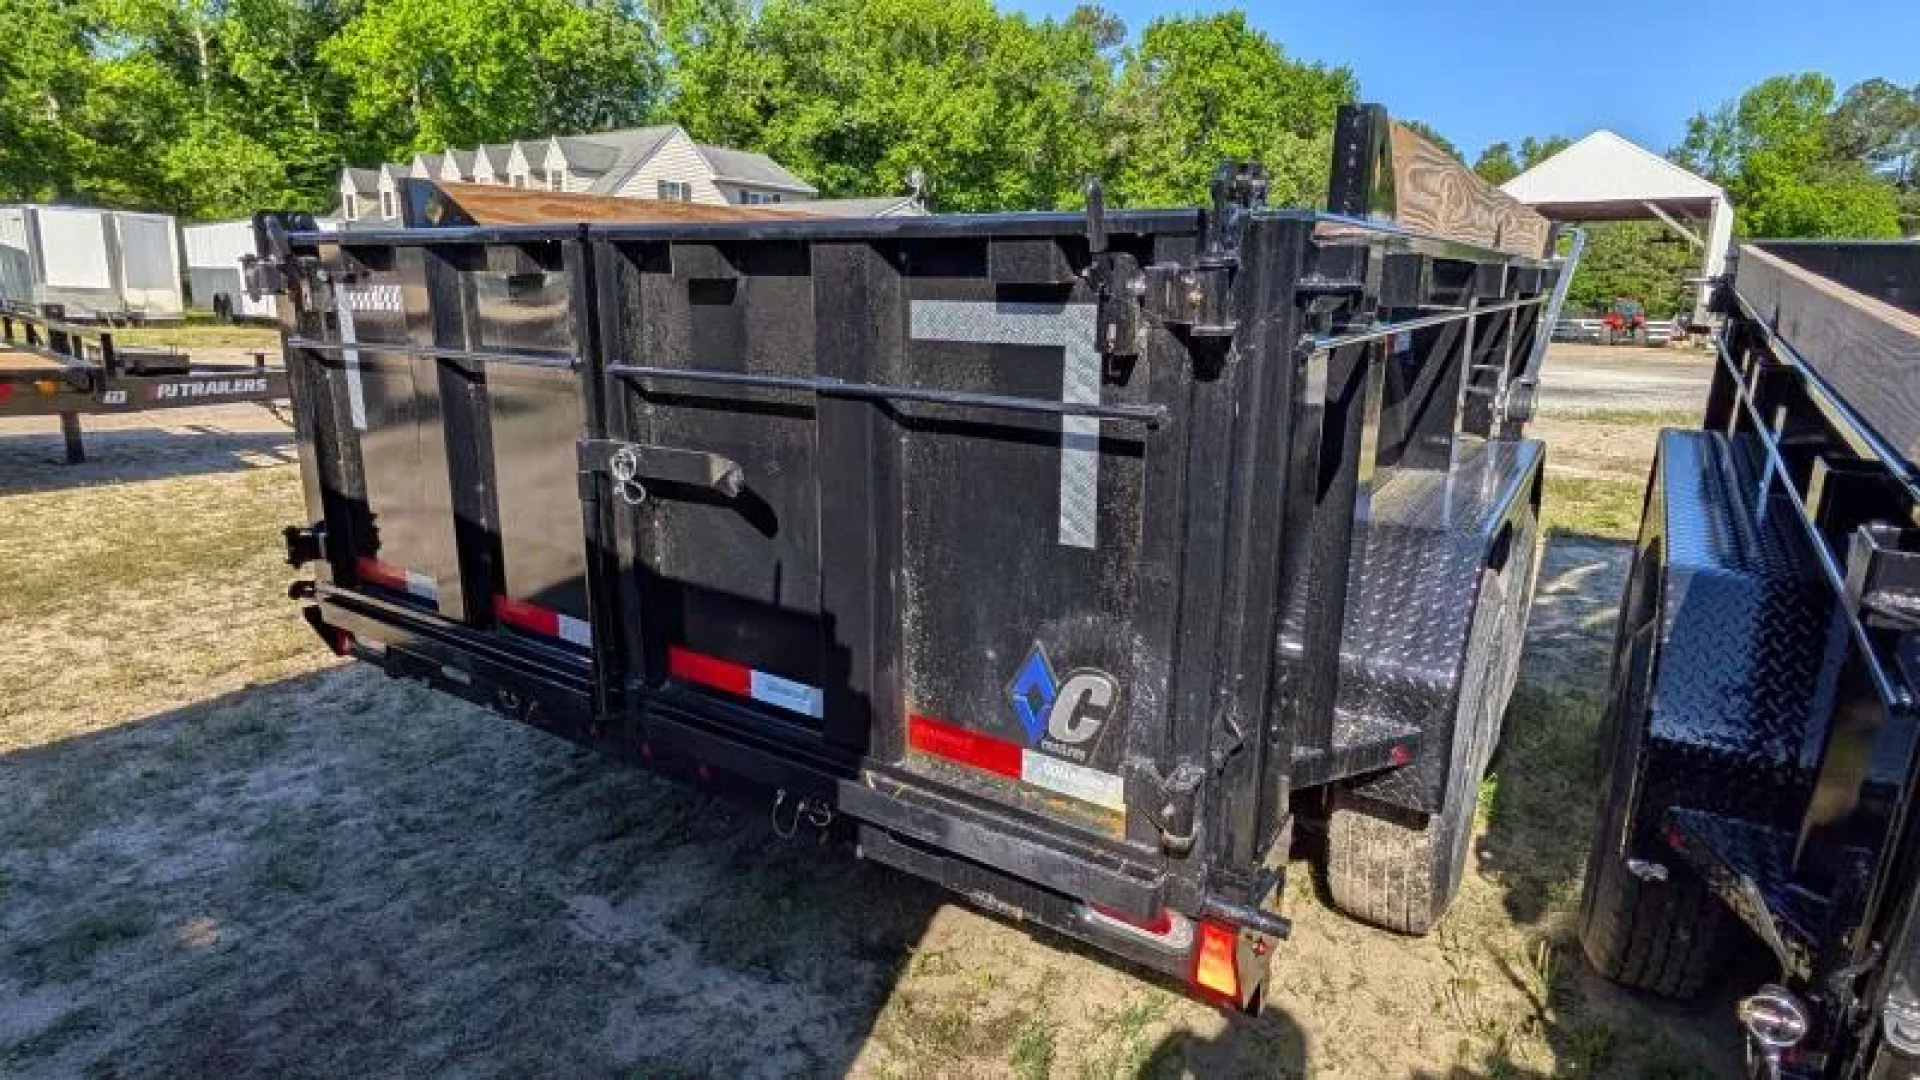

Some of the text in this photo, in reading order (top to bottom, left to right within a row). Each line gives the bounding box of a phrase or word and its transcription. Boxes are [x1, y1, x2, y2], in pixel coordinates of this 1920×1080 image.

[157, 378, 268, 399] PJ TRAILERS
[1048, 676, 1112, 742] C
